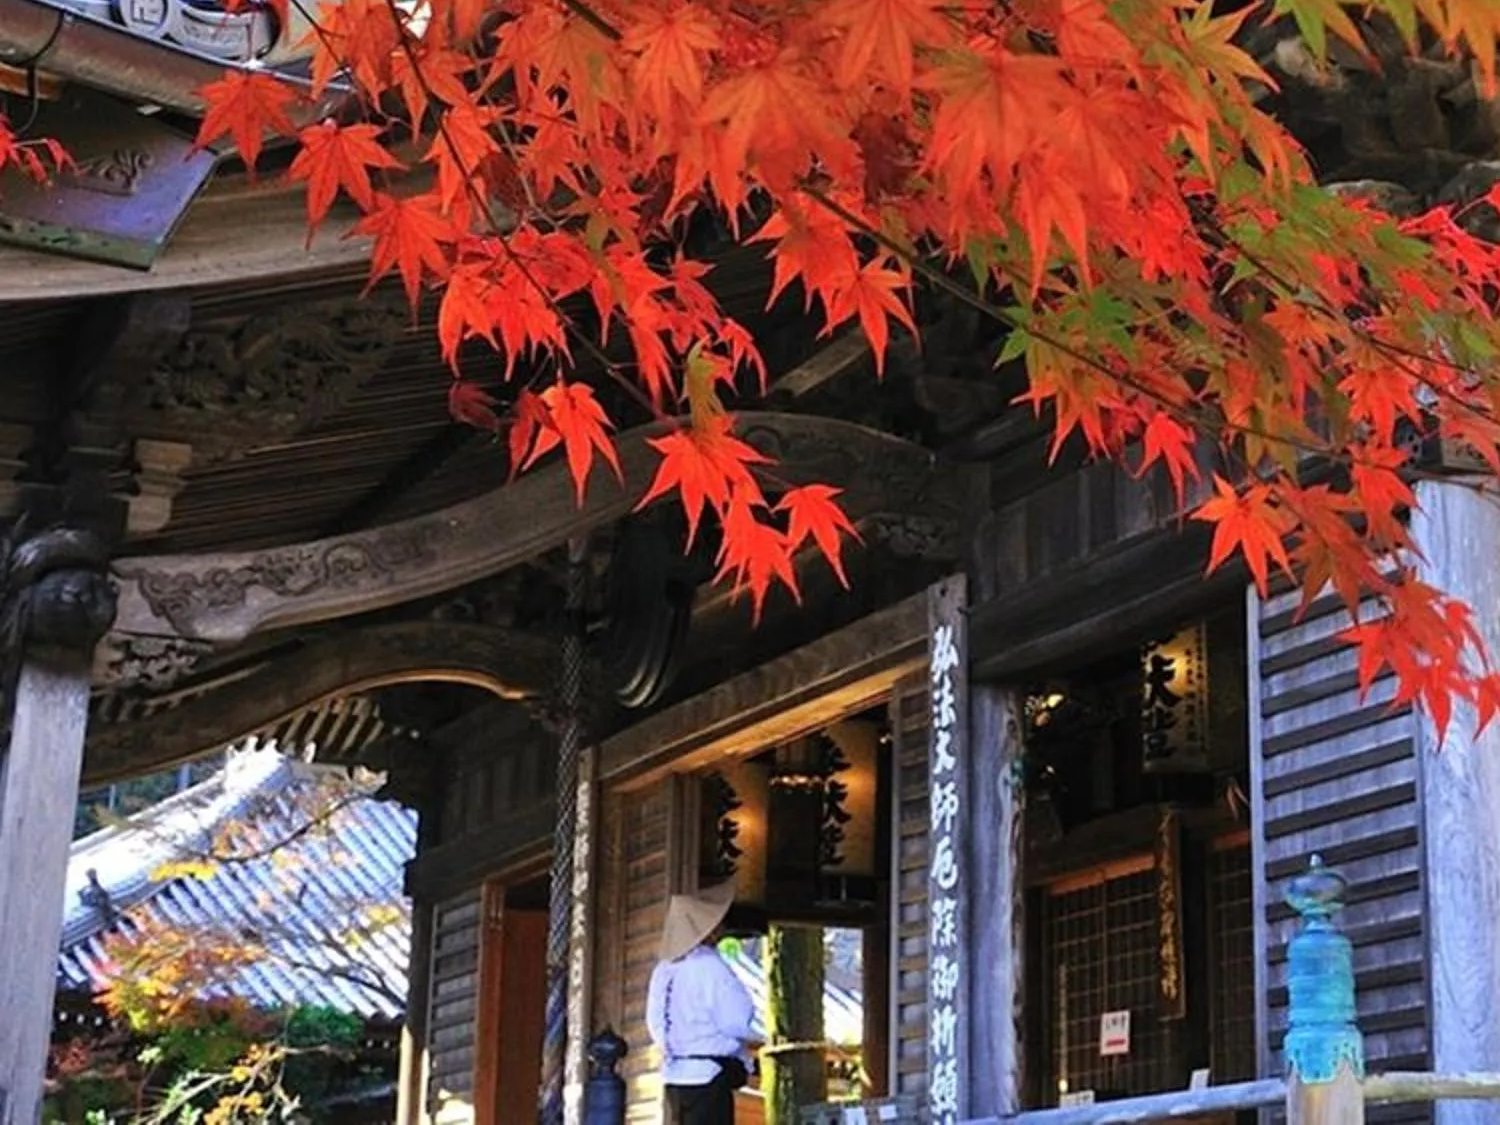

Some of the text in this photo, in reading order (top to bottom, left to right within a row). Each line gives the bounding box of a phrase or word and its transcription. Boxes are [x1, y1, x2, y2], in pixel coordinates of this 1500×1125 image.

[931, 626, 960, 1125] 弘法大師厄除御祈願
